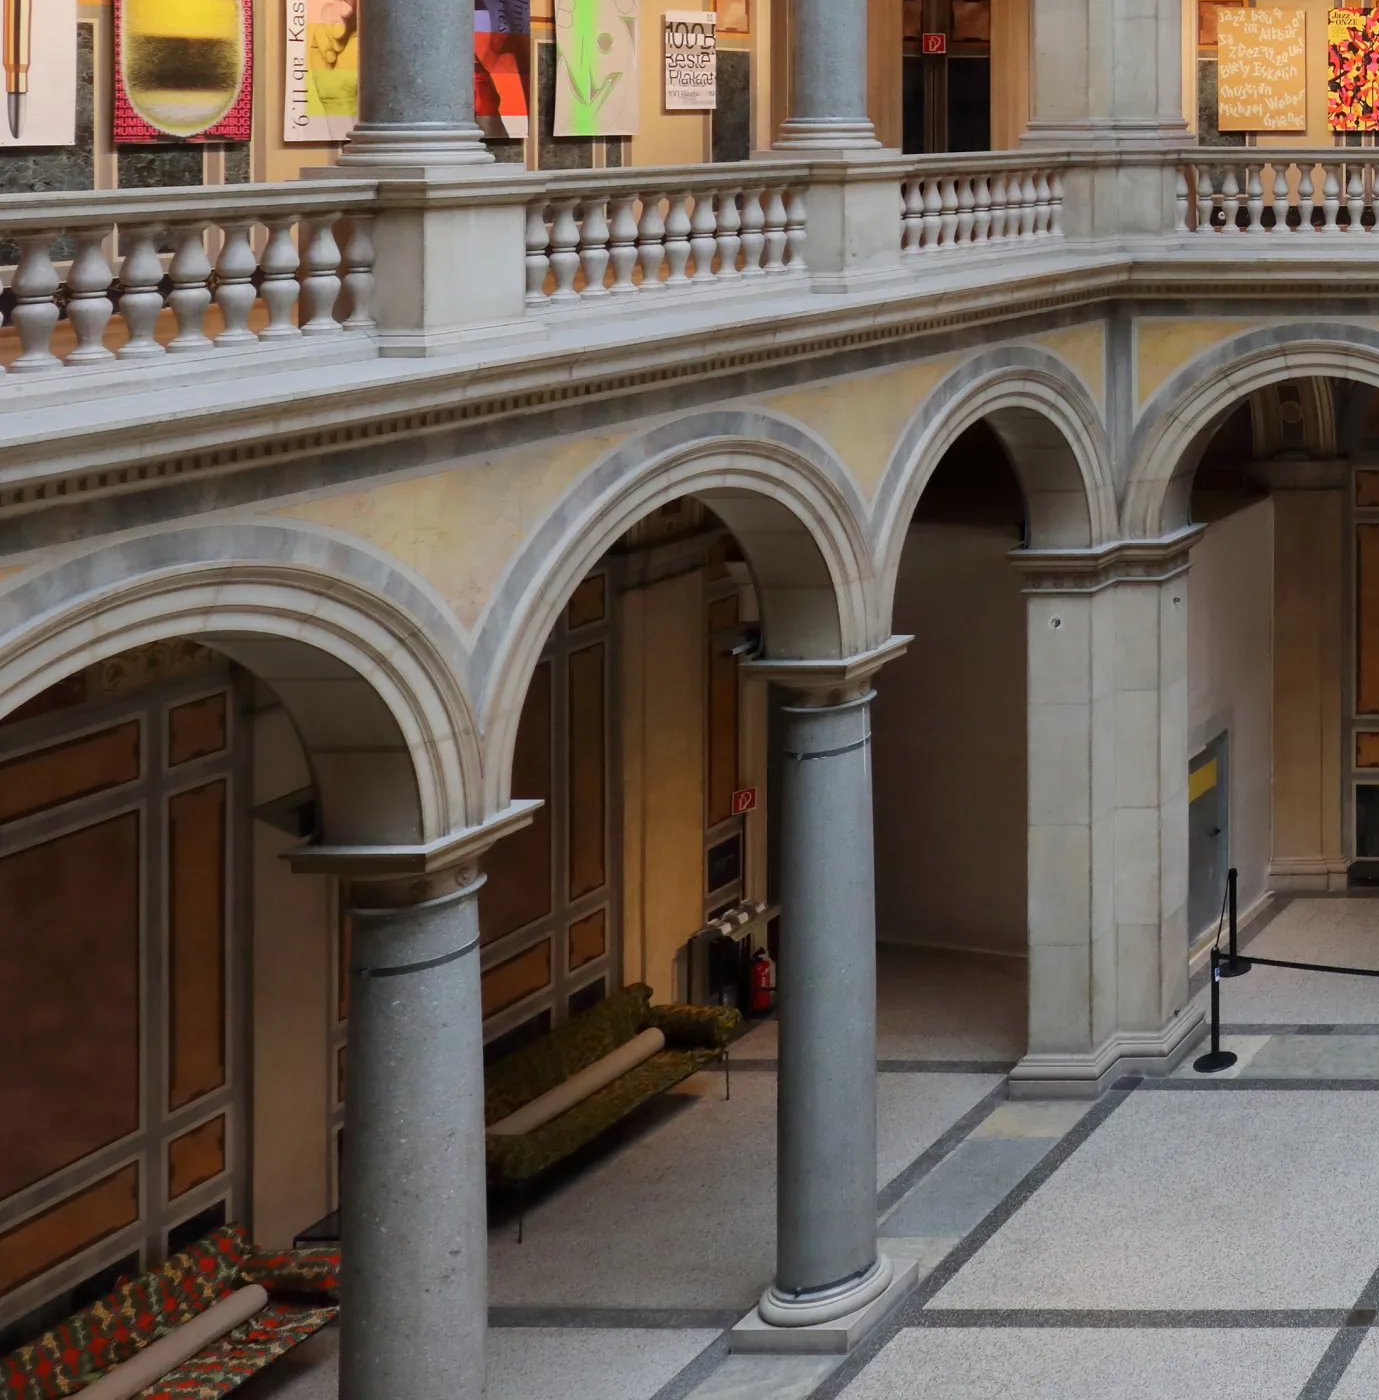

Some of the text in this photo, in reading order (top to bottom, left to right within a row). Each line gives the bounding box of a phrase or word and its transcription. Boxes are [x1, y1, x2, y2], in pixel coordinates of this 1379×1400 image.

[1219, 9, 1246, 27] Jazz
[1331, 12, 1351, 20] Jazz
[114, 126, 250, 135] HUMBUG HUMBUG
